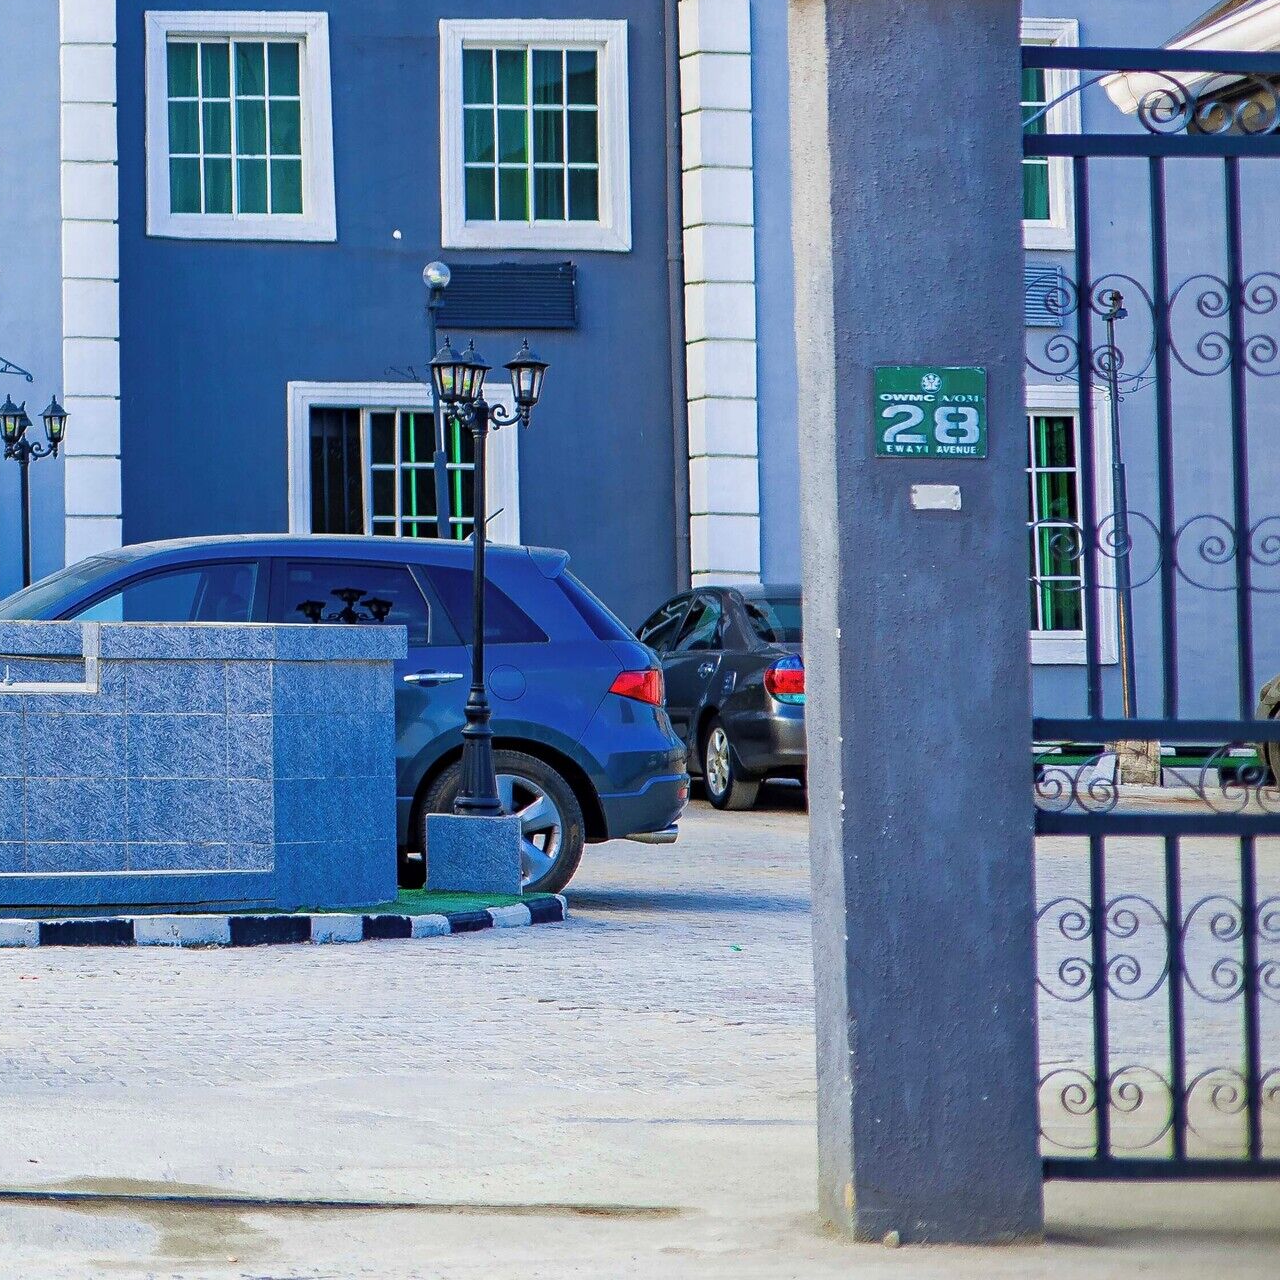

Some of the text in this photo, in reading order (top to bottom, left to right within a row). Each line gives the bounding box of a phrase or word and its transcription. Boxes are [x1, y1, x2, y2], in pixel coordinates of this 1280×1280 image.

[880, 393, 936, 402] OWMC
[881, 404, 980, 444] 28
[936, 445, 977, 454] AVENUE
